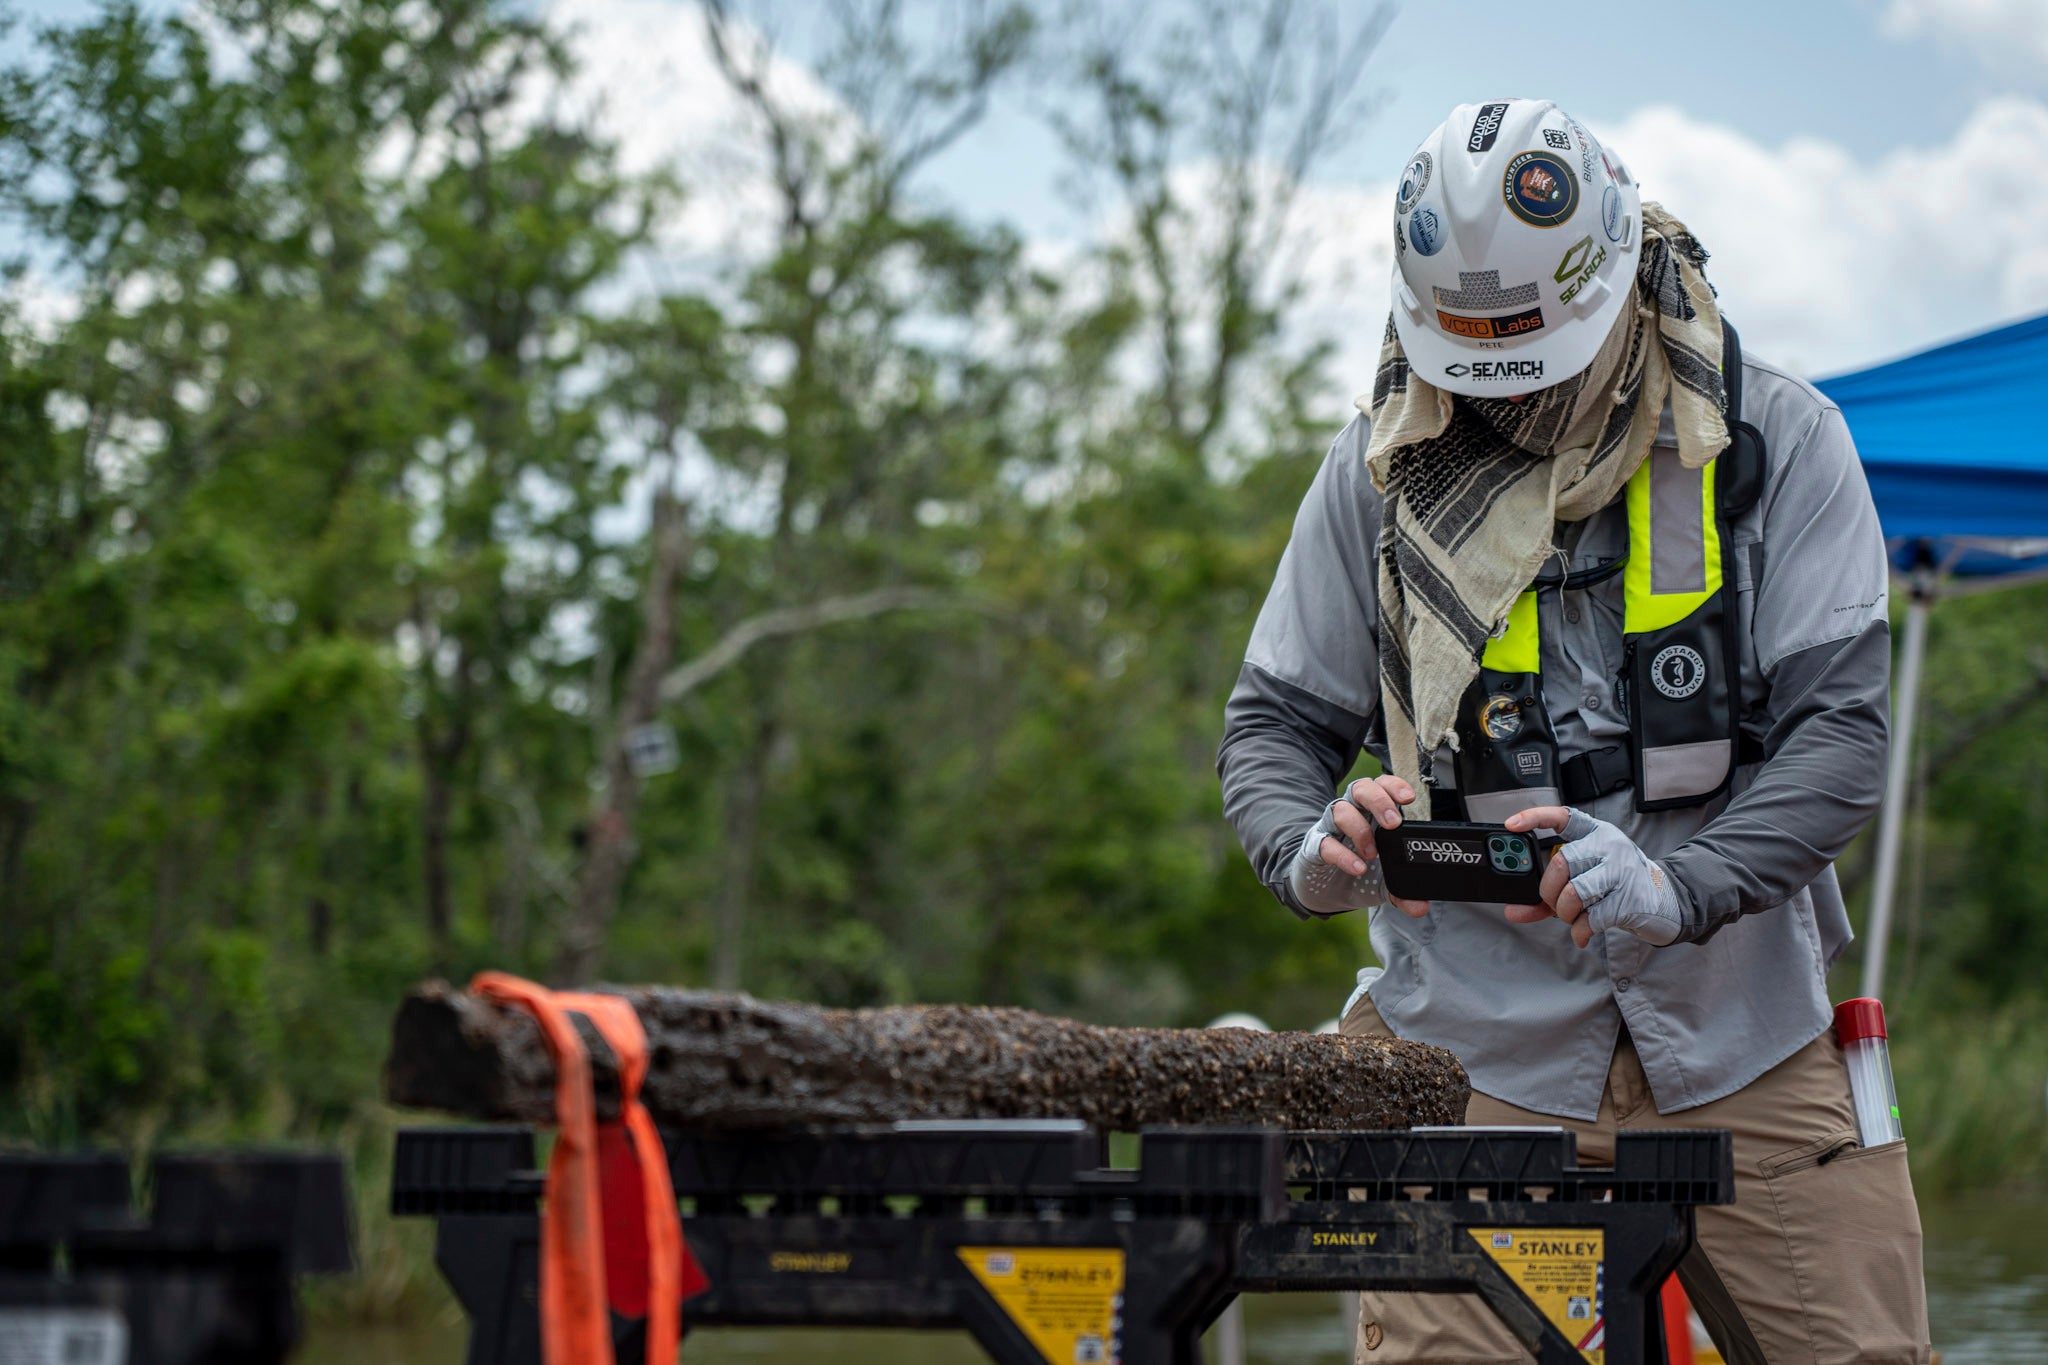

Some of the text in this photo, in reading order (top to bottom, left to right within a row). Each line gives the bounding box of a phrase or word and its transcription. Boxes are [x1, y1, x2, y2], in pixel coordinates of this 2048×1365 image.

[1505, 153, 1533, 200] VOLUNTEER
[1559, 245, 1607, 305] SEARCH
[1440, 316, 1541, 334] VCTO Labs
[1472, 360, 1544, 377] SEARCH
[1654, 647, 1704, 671] MUSTANG
[1654, 672, 1704, 697] SURVIVAL
[1521, 755, 1537, 764] HIT
[1432, 852, 1482, 864] 071707
[1312, 1232, 1377, 1246] STANLEY
[1519, 1242, 1597, 1256] STANLEY
